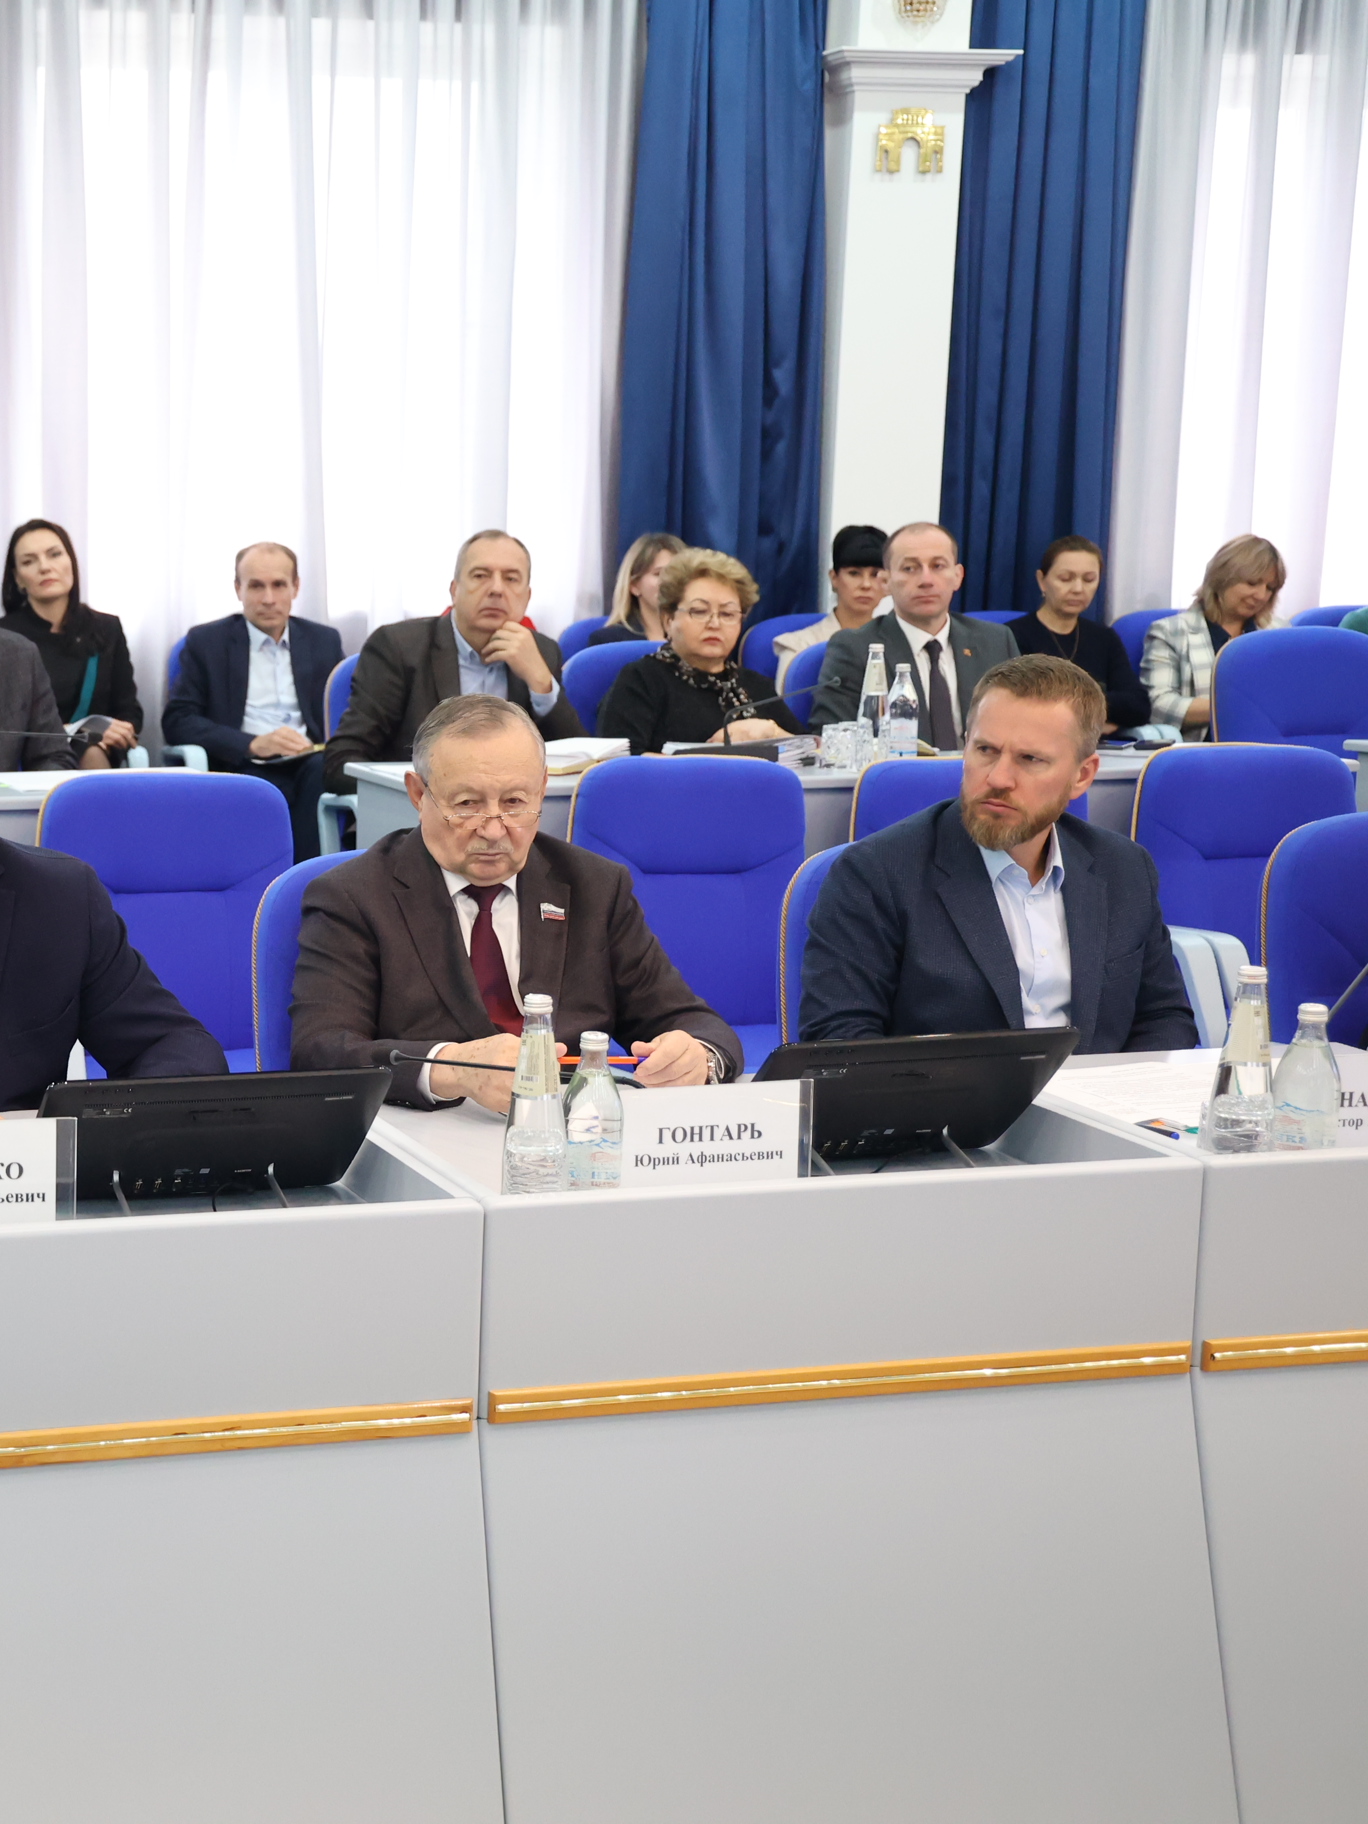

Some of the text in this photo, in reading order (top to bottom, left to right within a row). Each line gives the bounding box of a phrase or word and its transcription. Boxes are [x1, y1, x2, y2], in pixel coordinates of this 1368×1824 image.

[657, 1122, 763, 1145] ГОНТАРЬ
[1338, 1117, 1363, 1131] тор
[634, 1149, 783, 1170] Юрий Афанасьевич
